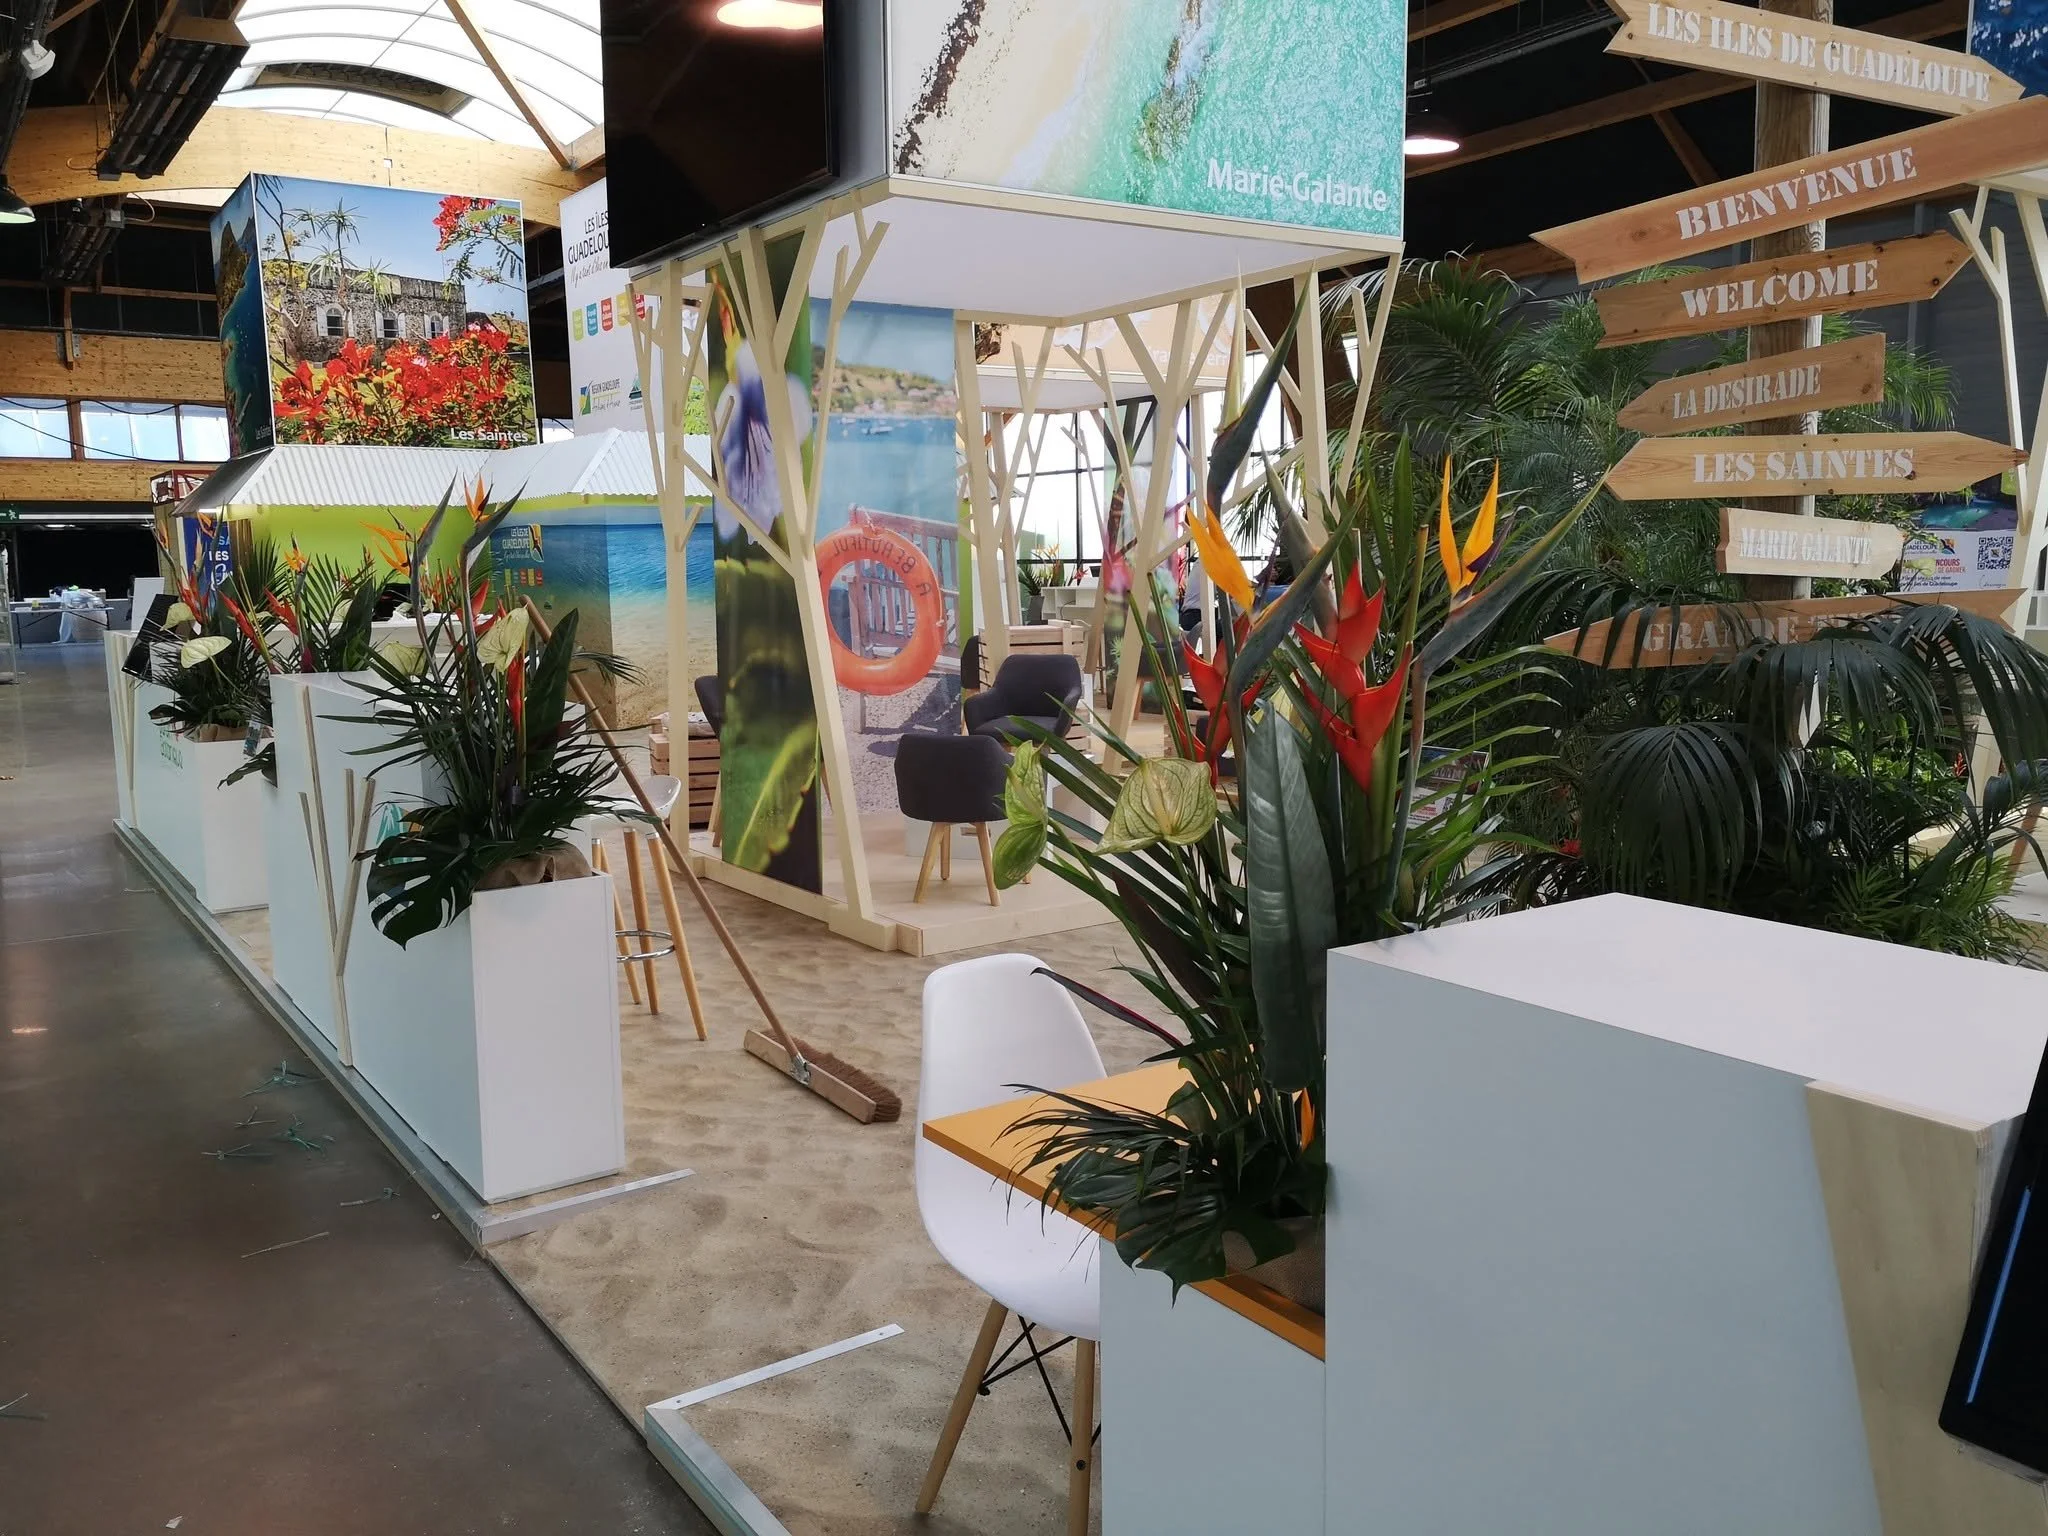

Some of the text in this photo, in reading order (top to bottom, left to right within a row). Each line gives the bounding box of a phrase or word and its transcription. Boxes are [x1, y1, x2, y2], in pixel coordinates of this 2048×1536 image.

[1648, 3, 1990, 102] LES ILES DE GUADELOUPE
[1207, 157, 1387, 212] Marie-Galante
[1675, 147, 1917, 241] BIENVENUE
[584, 216, 596, 235] LES
[567, 229, 609, 265] GUADELOU
[1681, 259, 1879, 318] WELCOME
[1672, 364, 1822, 419] LA DESIRADE
[450, 427, 529, 442] Les Saintes
[1693, 447, 1915, 484] LES SAINTES
[1739, 527, 1873, 565] MARIE GALANTE
[1936, 558, 1961, 567] NCOURS
